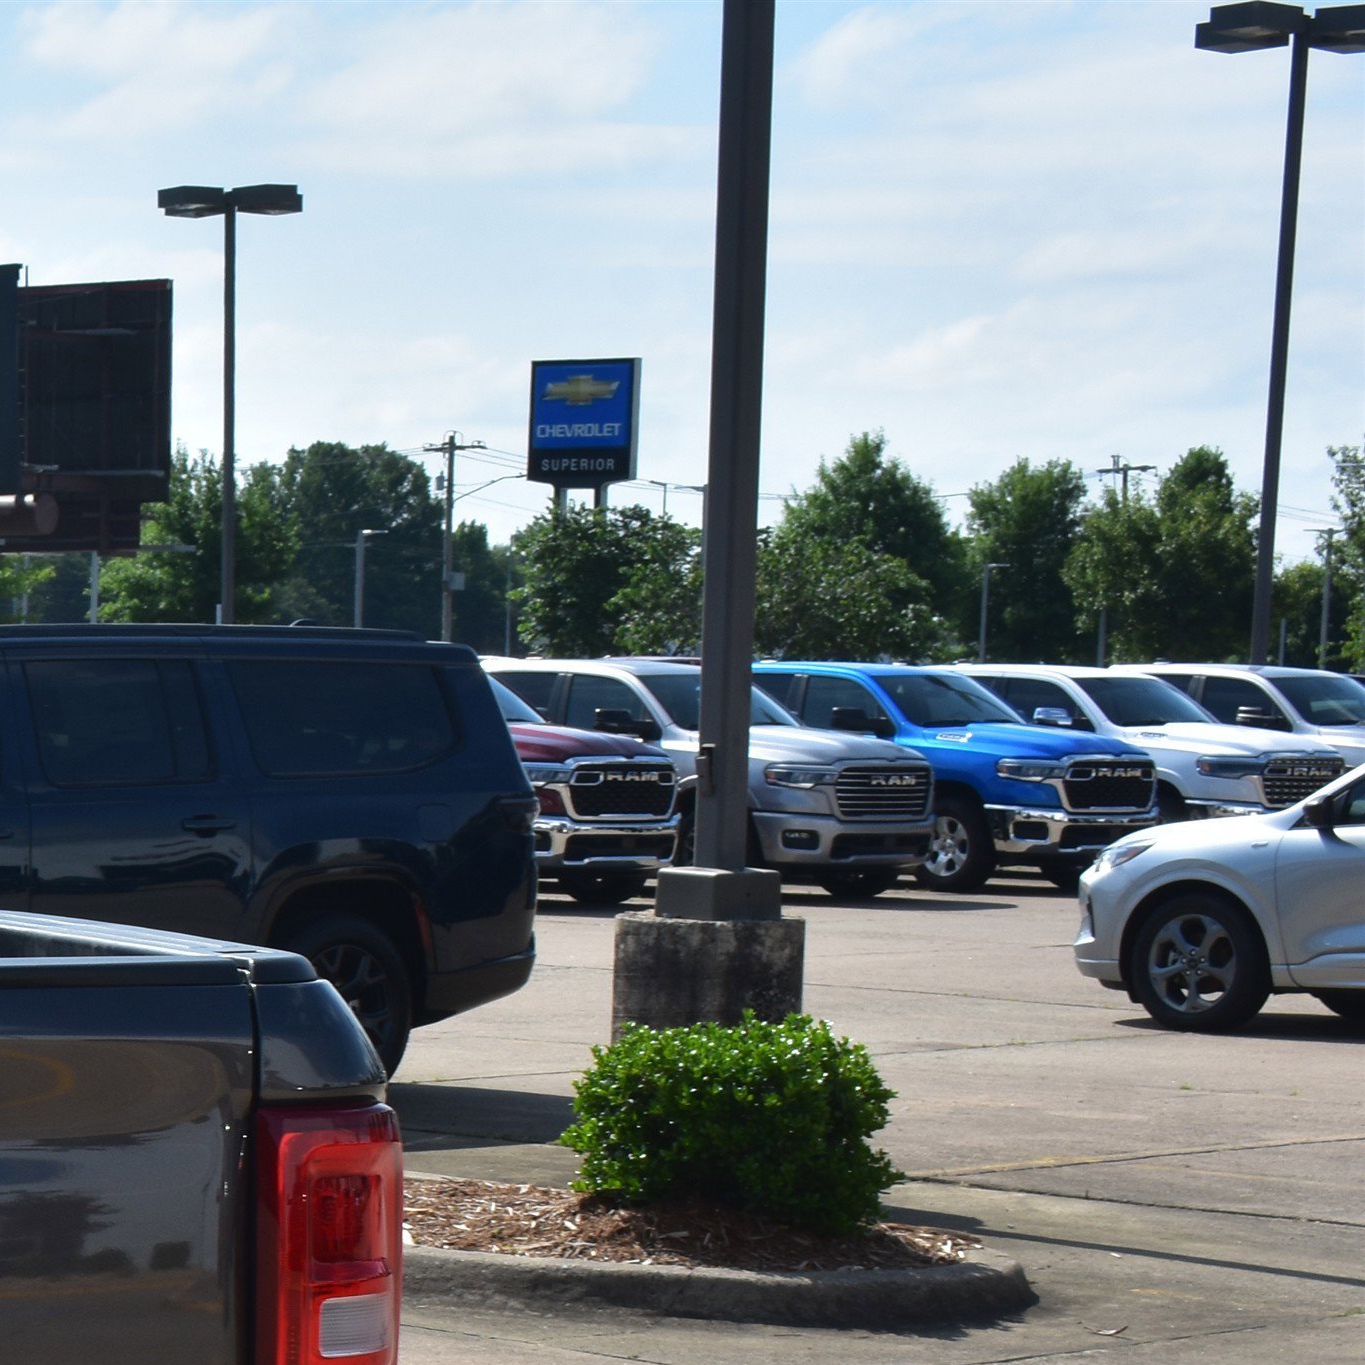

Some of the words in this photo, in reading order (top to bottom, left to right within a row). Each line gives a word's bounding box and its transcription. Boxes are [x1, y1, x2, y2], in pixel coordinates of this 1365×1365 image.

[536, 423, 621, 438] CHEVROLET
[541, 458, 615, 471] SUPERIOR
[606, 770, 659, 781] RAM
[1097, 768, 1141, 777] RAM
[871, 775, 917, 785] RAM
